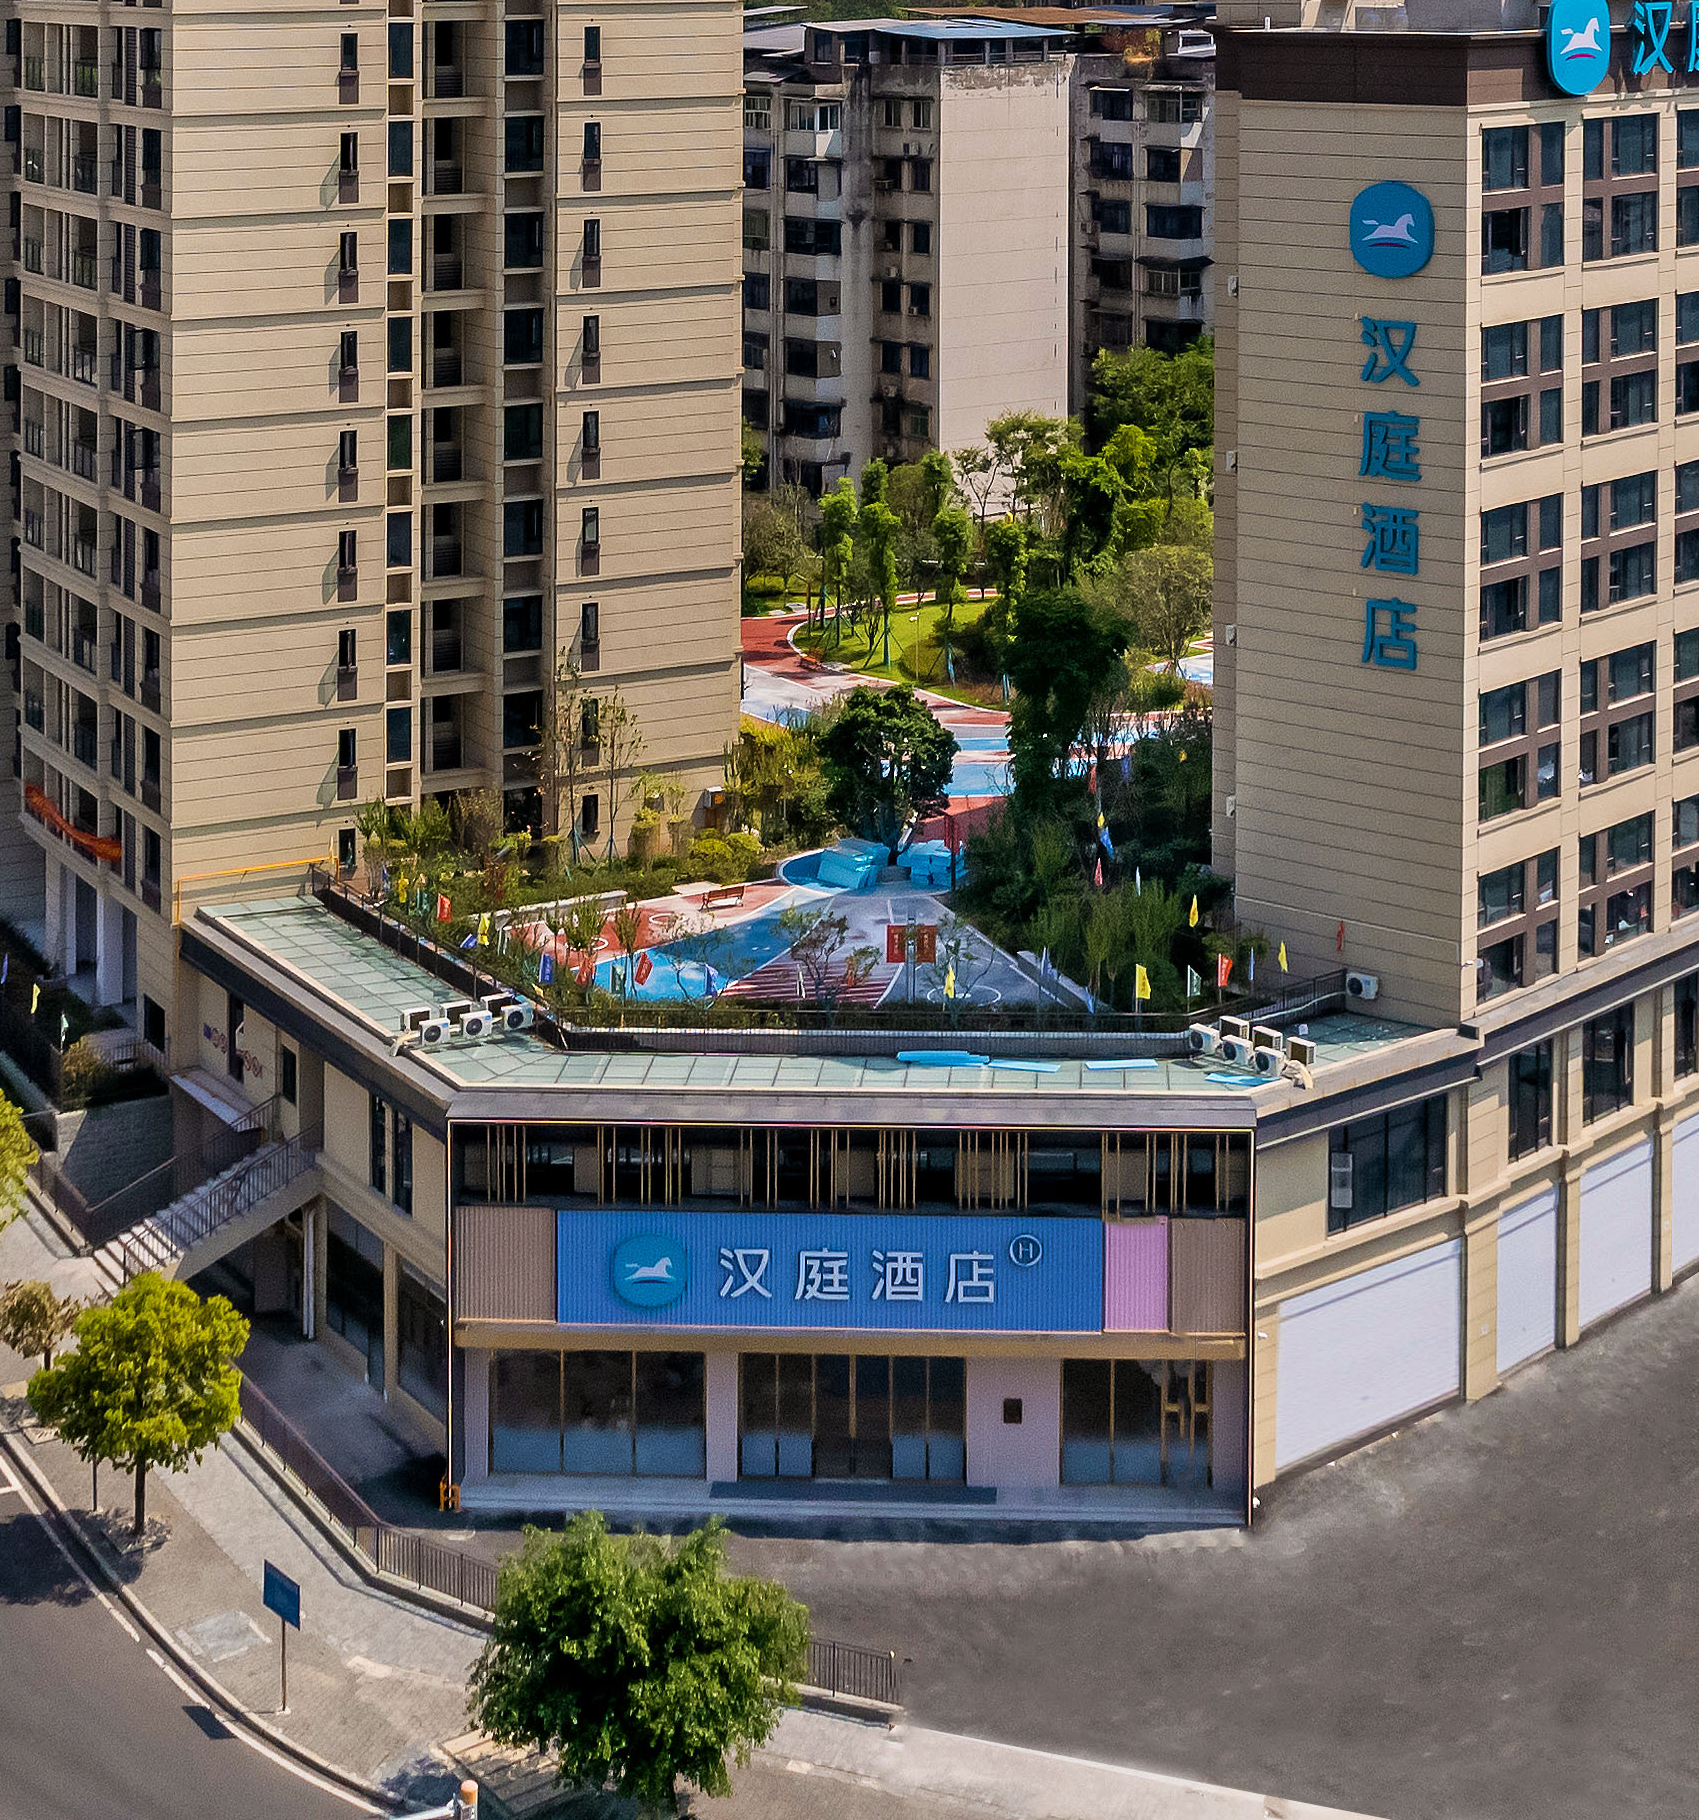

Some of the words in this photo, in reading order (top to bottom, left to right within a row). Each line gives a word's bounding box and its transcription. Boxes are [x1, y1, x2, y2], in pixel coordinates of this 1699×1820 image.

[1359, 315, 1423, 672] 汉庭酒店
[719, 1247, 995, 1304] 汉庭酒店
